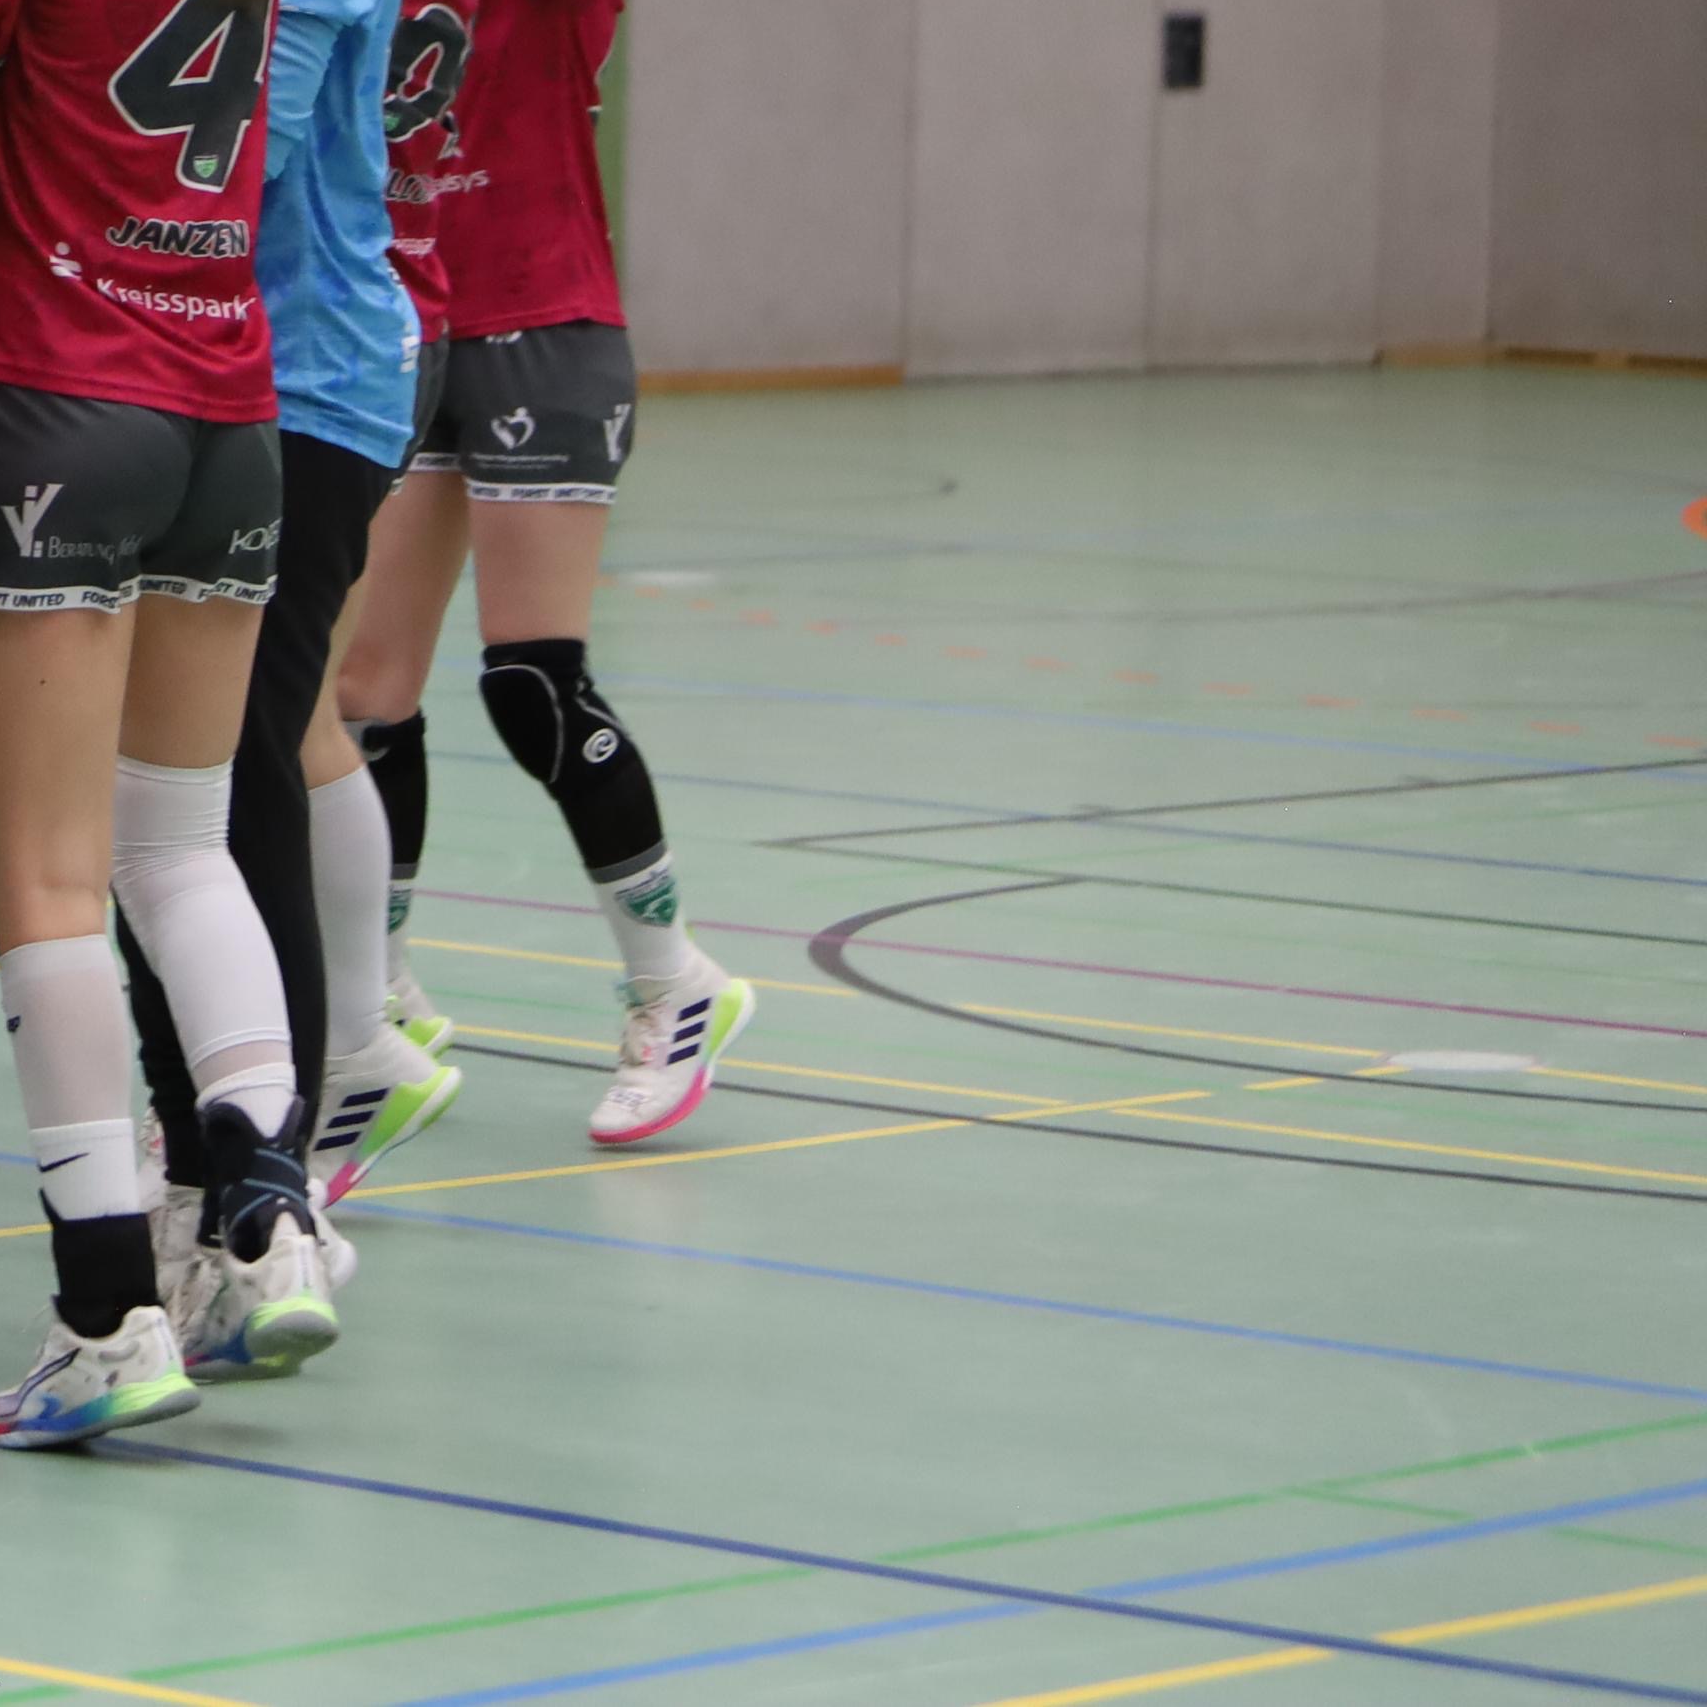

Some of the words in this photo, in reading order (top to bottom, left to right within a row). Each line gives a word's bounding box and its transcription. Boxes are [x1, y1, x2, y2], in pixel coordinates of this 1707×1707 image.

[105, 215, 250, 260] JANZEN
[95, 277, 257, 322] Kreisspark
[12, 593, 65, 608] UNITED
